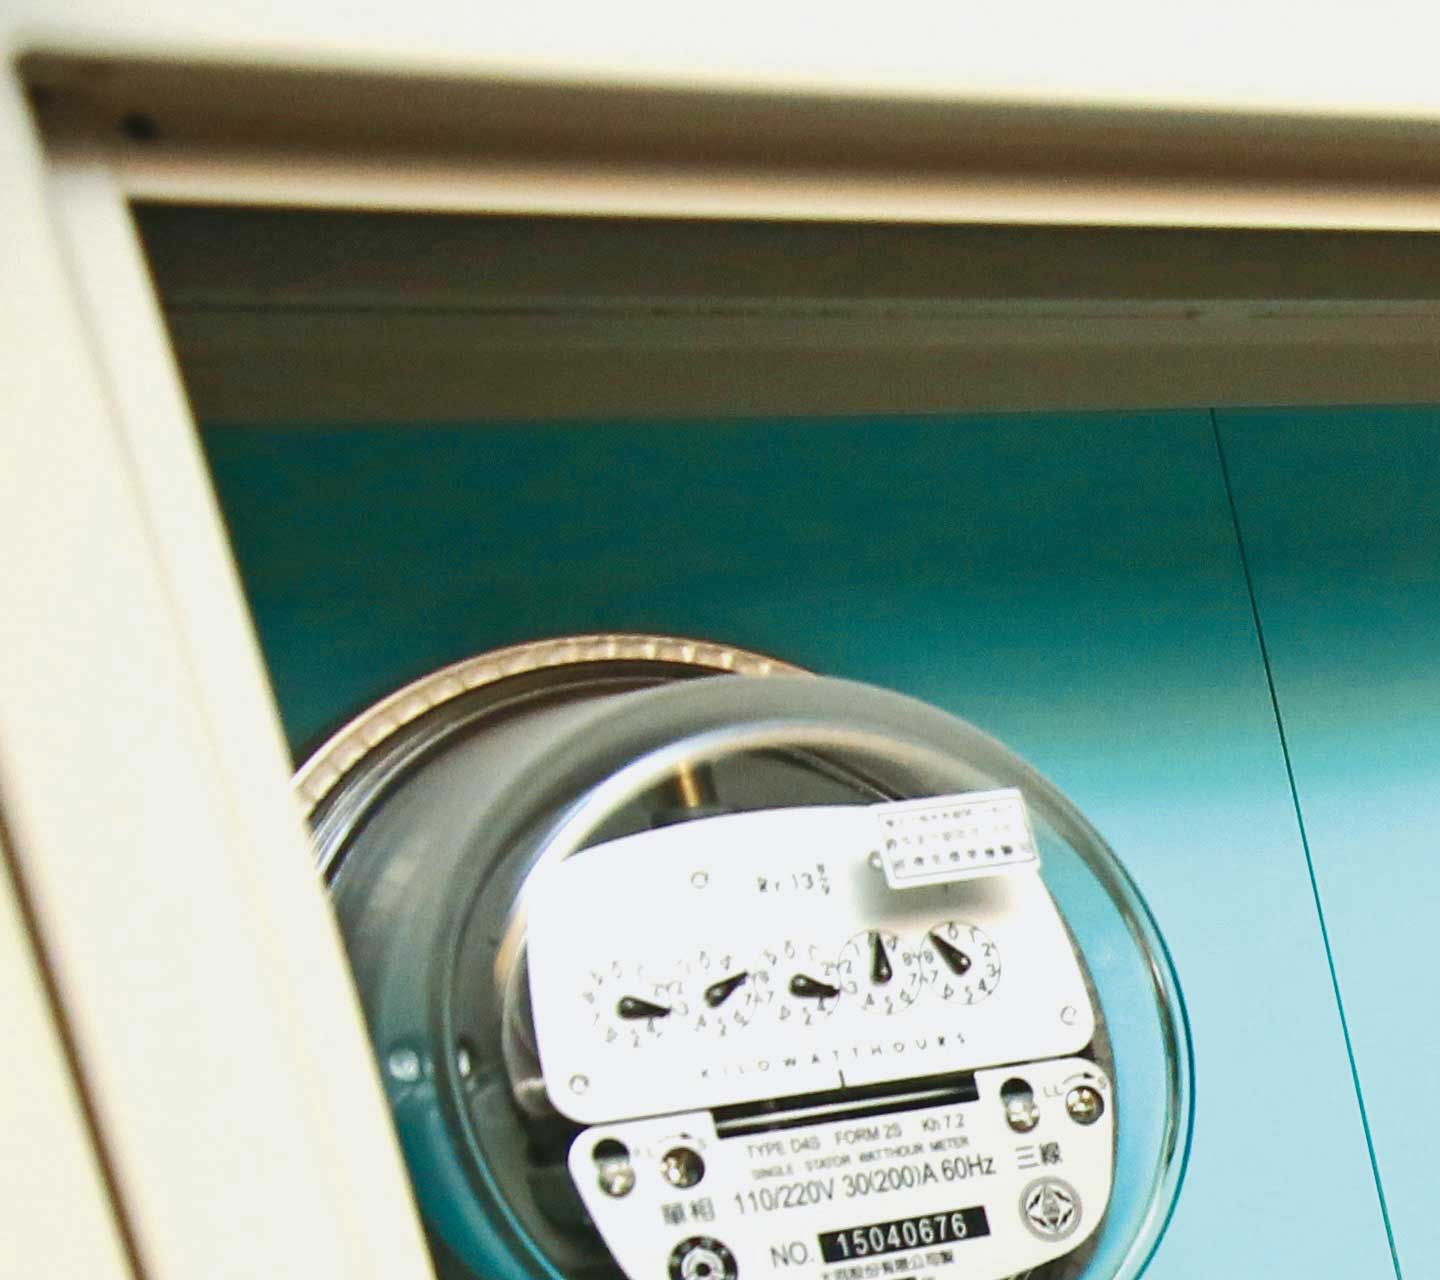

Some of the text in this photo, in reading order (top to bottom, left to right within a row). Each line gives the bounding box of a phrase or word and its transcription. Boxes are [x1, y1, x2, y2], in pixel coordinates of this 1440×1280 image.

[835, 1127, 879, 1145] FORM
[930, 1134, 969, 1154] METER
[734, 1156, 997, 1216] 110/220V 30(200)A 60Hz
[770, 1241, 815, 1270] NO.
[836, 1212, 969, 1258] 15040676
